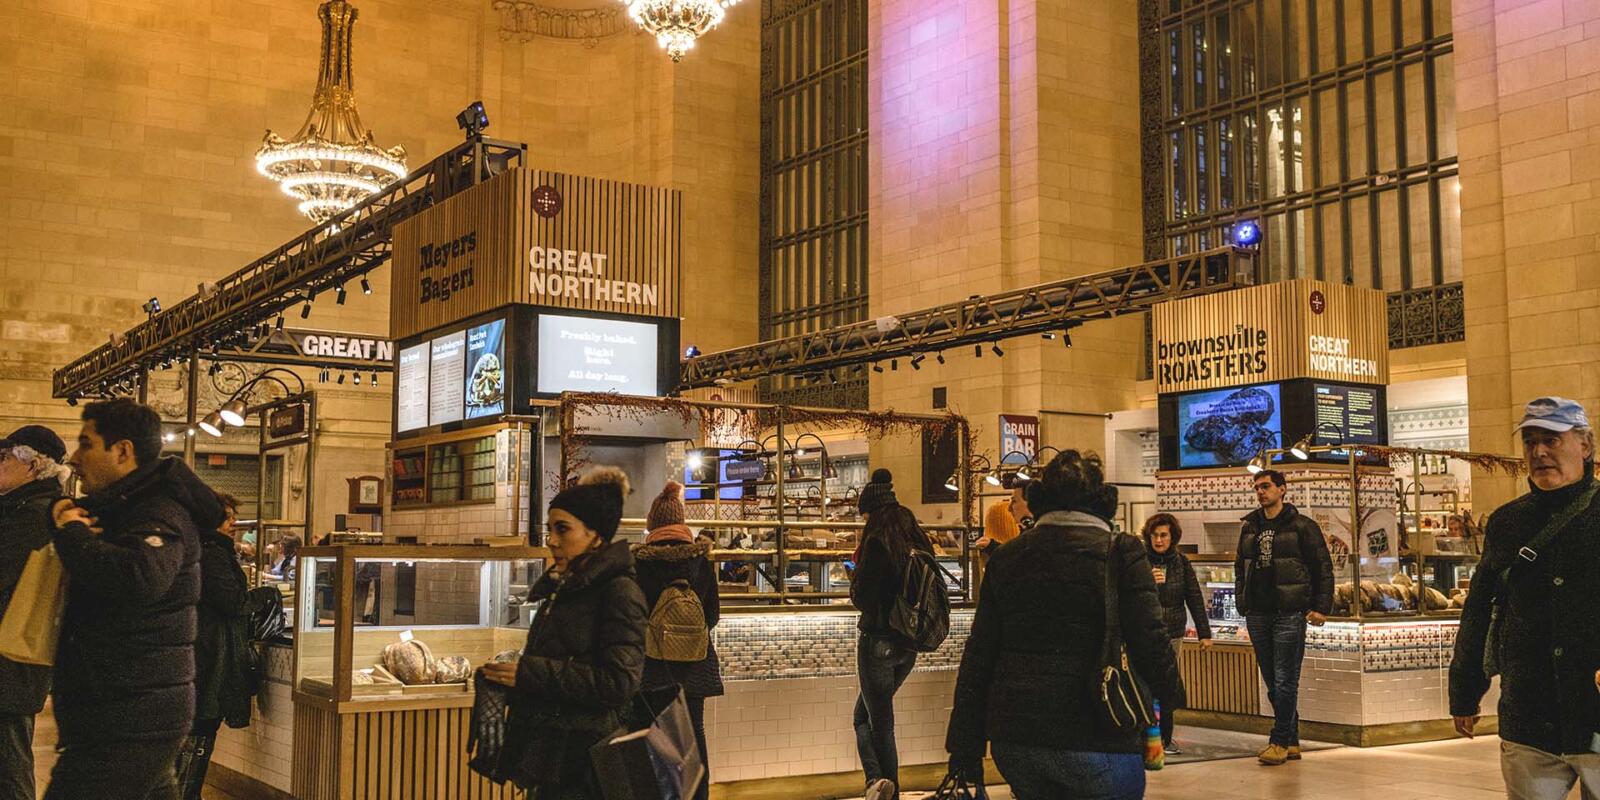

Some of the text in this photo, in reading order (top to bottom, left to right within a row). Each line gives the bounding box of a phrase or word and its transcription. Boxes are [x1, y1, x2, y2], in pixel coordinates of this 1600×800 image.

[420, 231, 476, 272] Meyers
[529, 246, 607, 275] GREAT
[420, 262, 474, 304] Bageri
[529, 272, 658, 306] NORTHERN
[303, 335, 374, 360] GREAT
[560, 330, 601, 342] Freshly
[1158, 324, 1267, 360] brownsville
[1309, 335, 1350, 355] GREAT
[583, 346, 614, 358] Right
[568, 370, 583, 379] All
[585, 370, 603, 381] day
[1158, 350, 1267, 385] ROASTERS
[1309, 354, 1377, 376] NORTHERN
[1004, 422, 1035, 437] GRAIN
[1004, 437, 1035, 457] BAR
